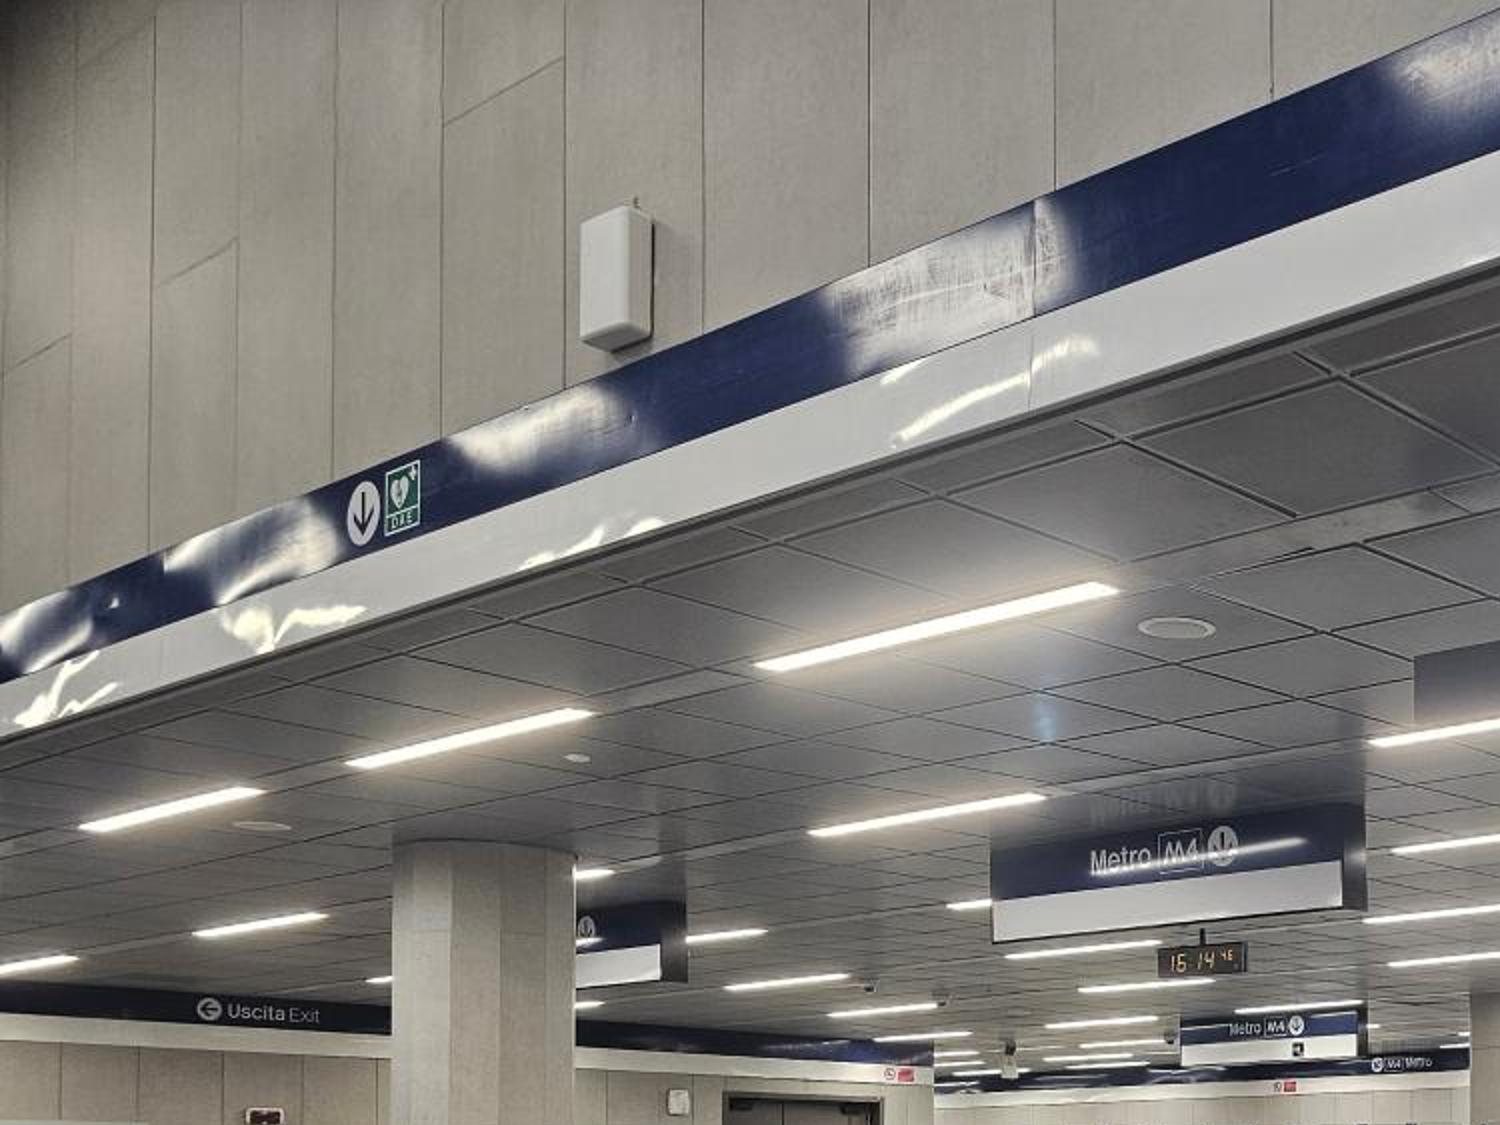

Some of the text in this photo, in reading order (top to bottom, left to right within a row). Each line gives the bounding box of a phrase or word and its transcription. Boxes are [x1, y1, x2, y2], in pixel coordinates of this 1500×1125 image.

[391, 511, 413, 529] DAE
[1090, 838, 1199, 876] Metro M4
[227, 1003, 320, 1024] Uscita Exit
[1230, 1022, 1262, 1037] Metro
